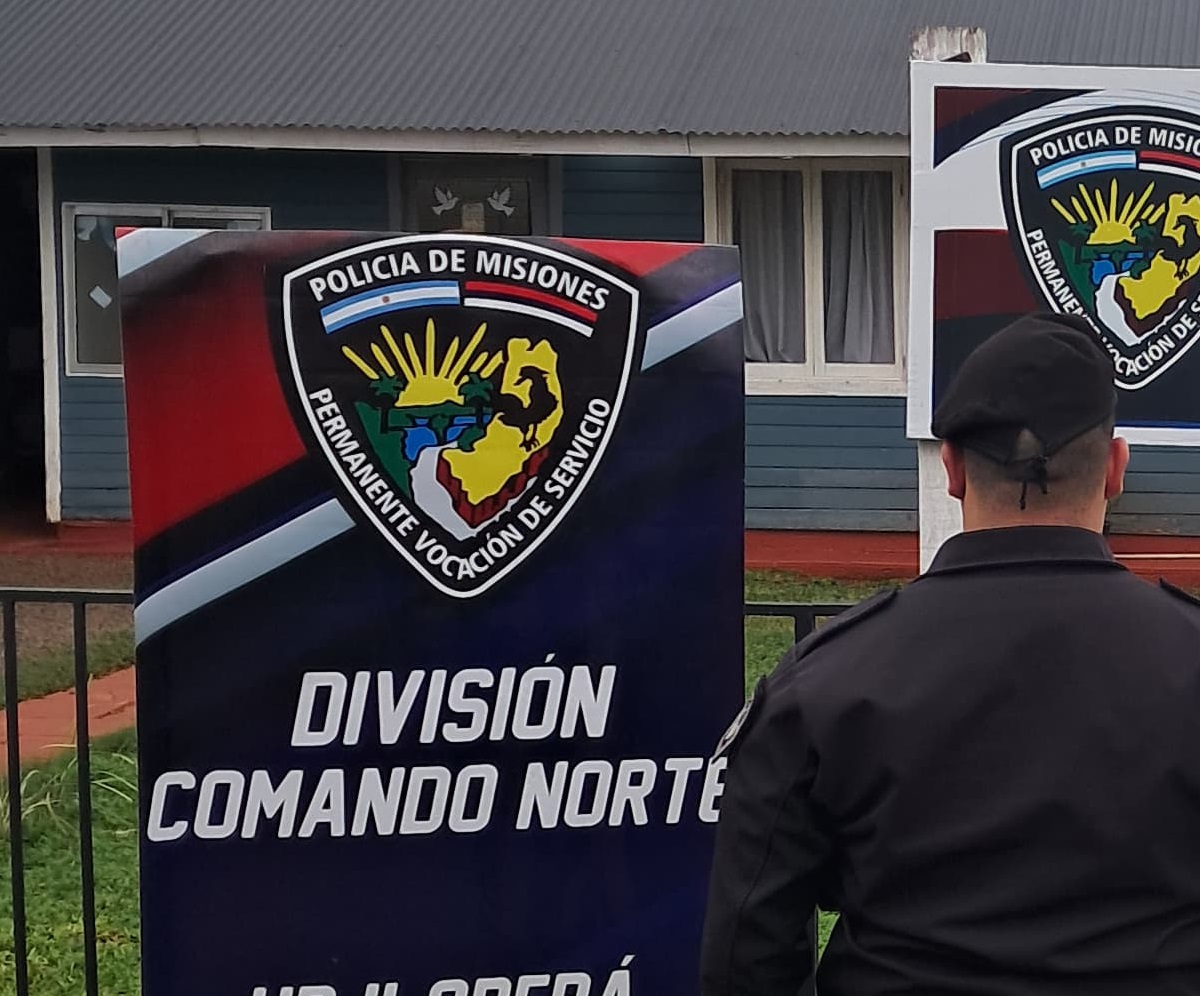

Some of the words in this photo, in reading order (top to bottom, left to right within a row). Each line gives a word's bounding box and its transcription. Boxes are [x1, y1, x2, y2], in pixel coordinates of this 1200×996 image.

[1029, 128, 1109, 166] POLICIA
[1115, 126, 1141, 145] DE
[308, 249, 421, 302] POLICIA
[429, 248, 466, 272] DE
[475, 249, 611, 310] MISIONES
[1171, 317, 1198, 342] DE
[309, 387, 420, 537] PERMANENTE
[413, 528, 525, 581] VOCACIÓN
[517, 495, 553, 536] DE
[544, 397, 612, 499] SERVICIO
[291, 653, 616, 746] DIVISIÓN
[146, 763, 500, 842] COMANDO
[516, 756, 729, 831] NORTE
